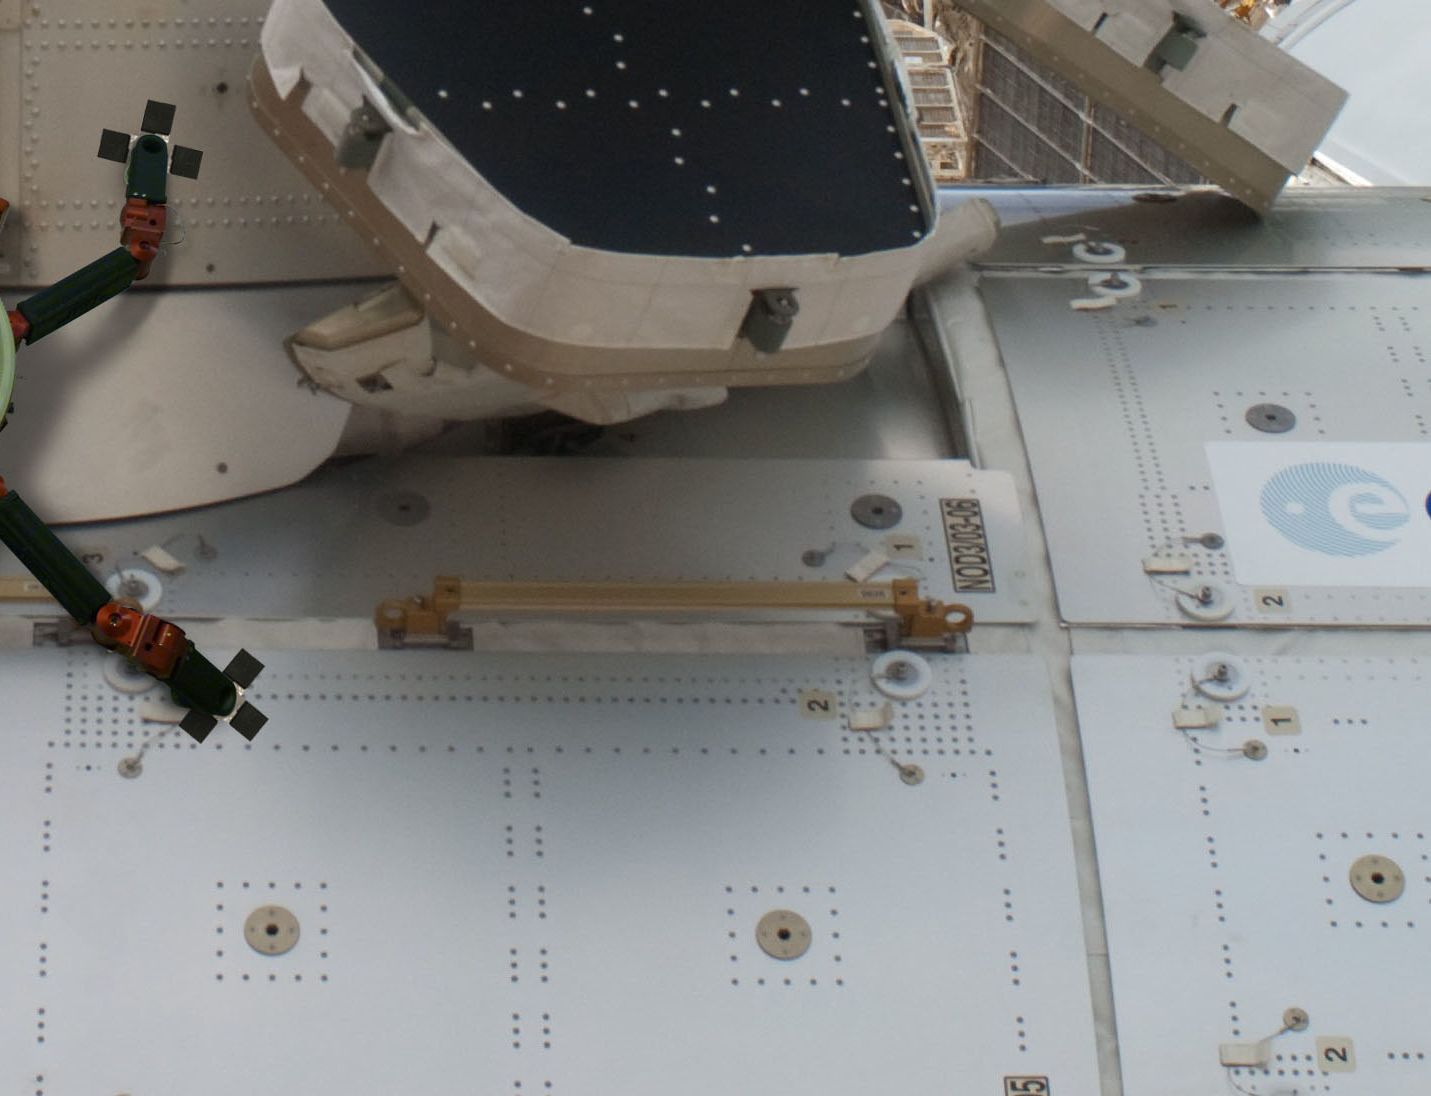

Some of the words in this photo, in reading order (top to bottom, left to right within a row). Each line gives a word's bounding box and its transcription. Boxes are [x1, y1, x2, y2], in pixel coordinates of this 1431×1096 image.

[945, 500, 992, 592] NOD3/03-06
[1262, 595, 1284, 607] 2
[808, 699, 830, 711] 2
[1270, 716, 1293, 727] 1
[1325, 1047, 1348, 1062] 2
